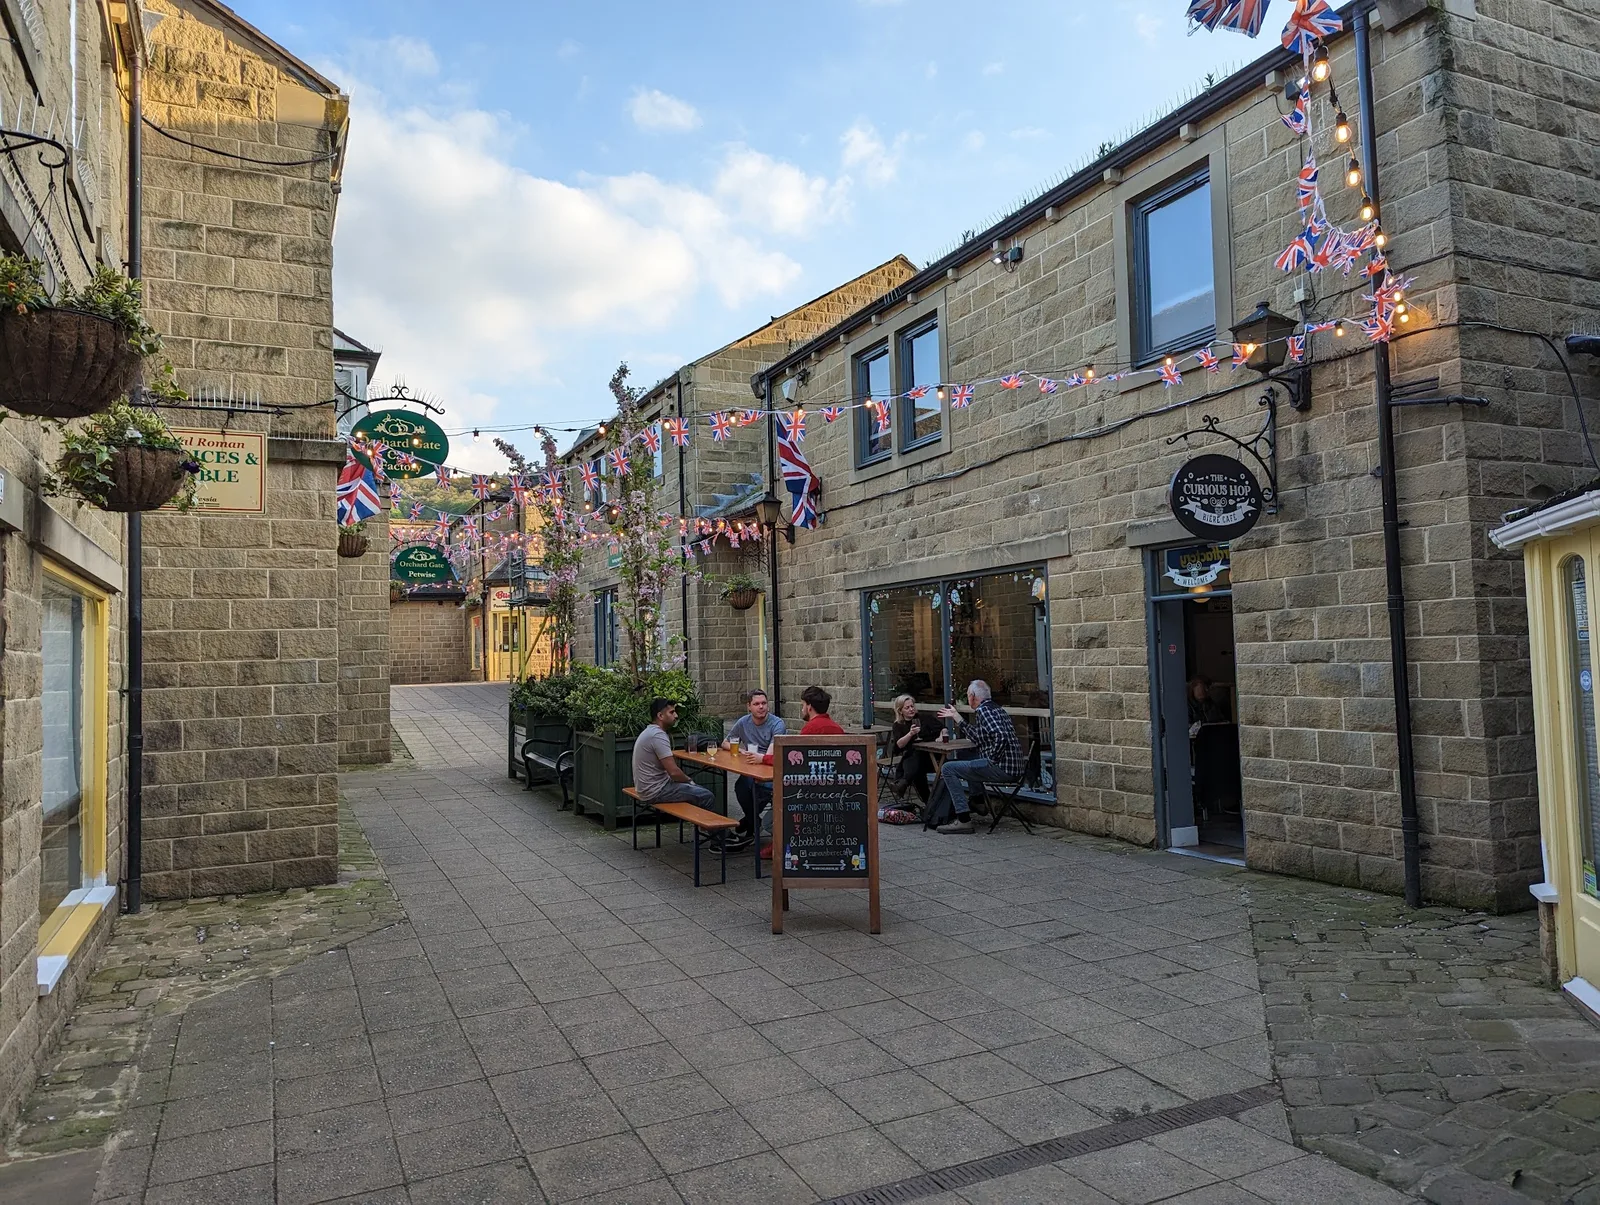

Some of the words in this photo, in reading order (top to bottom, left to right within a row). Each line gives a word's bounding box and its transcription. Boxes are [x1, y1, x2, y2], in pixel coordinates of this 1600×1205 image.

[197, 438, 245, 449] Roman
[193, 449, 240, 464] ICES
[245, 452, 260, 465] &
[200, 469, 240, 483] BLE
[1210, 474, 1224, 482] THE
[1183, 483, 1228, 496] CURIOUS
[1229, 485, 1252, 496] HOP
[399, 560, 428, 568] Orchard
[428, 561, 445, 569] Gate
[408, 570, 436, 578] Petwise
[1182, 575, 1209, 586] WELCOME
[808, 760, 837, 775] THE
[783, 774, 835, 787] CURIOUS
[837, 773, 863, 786] HOP
[845, 801, 861, 811] FOR
[792, 812, 802, 823] 10
[823, 812, 845, 823] lines
[794, 824, 801, 836] 3
[789, 835, 798, 848] &
[798, 835, 825, 847] bottles
[825, 834, 834, 846] &
[835, 837, 859, 847] cans
